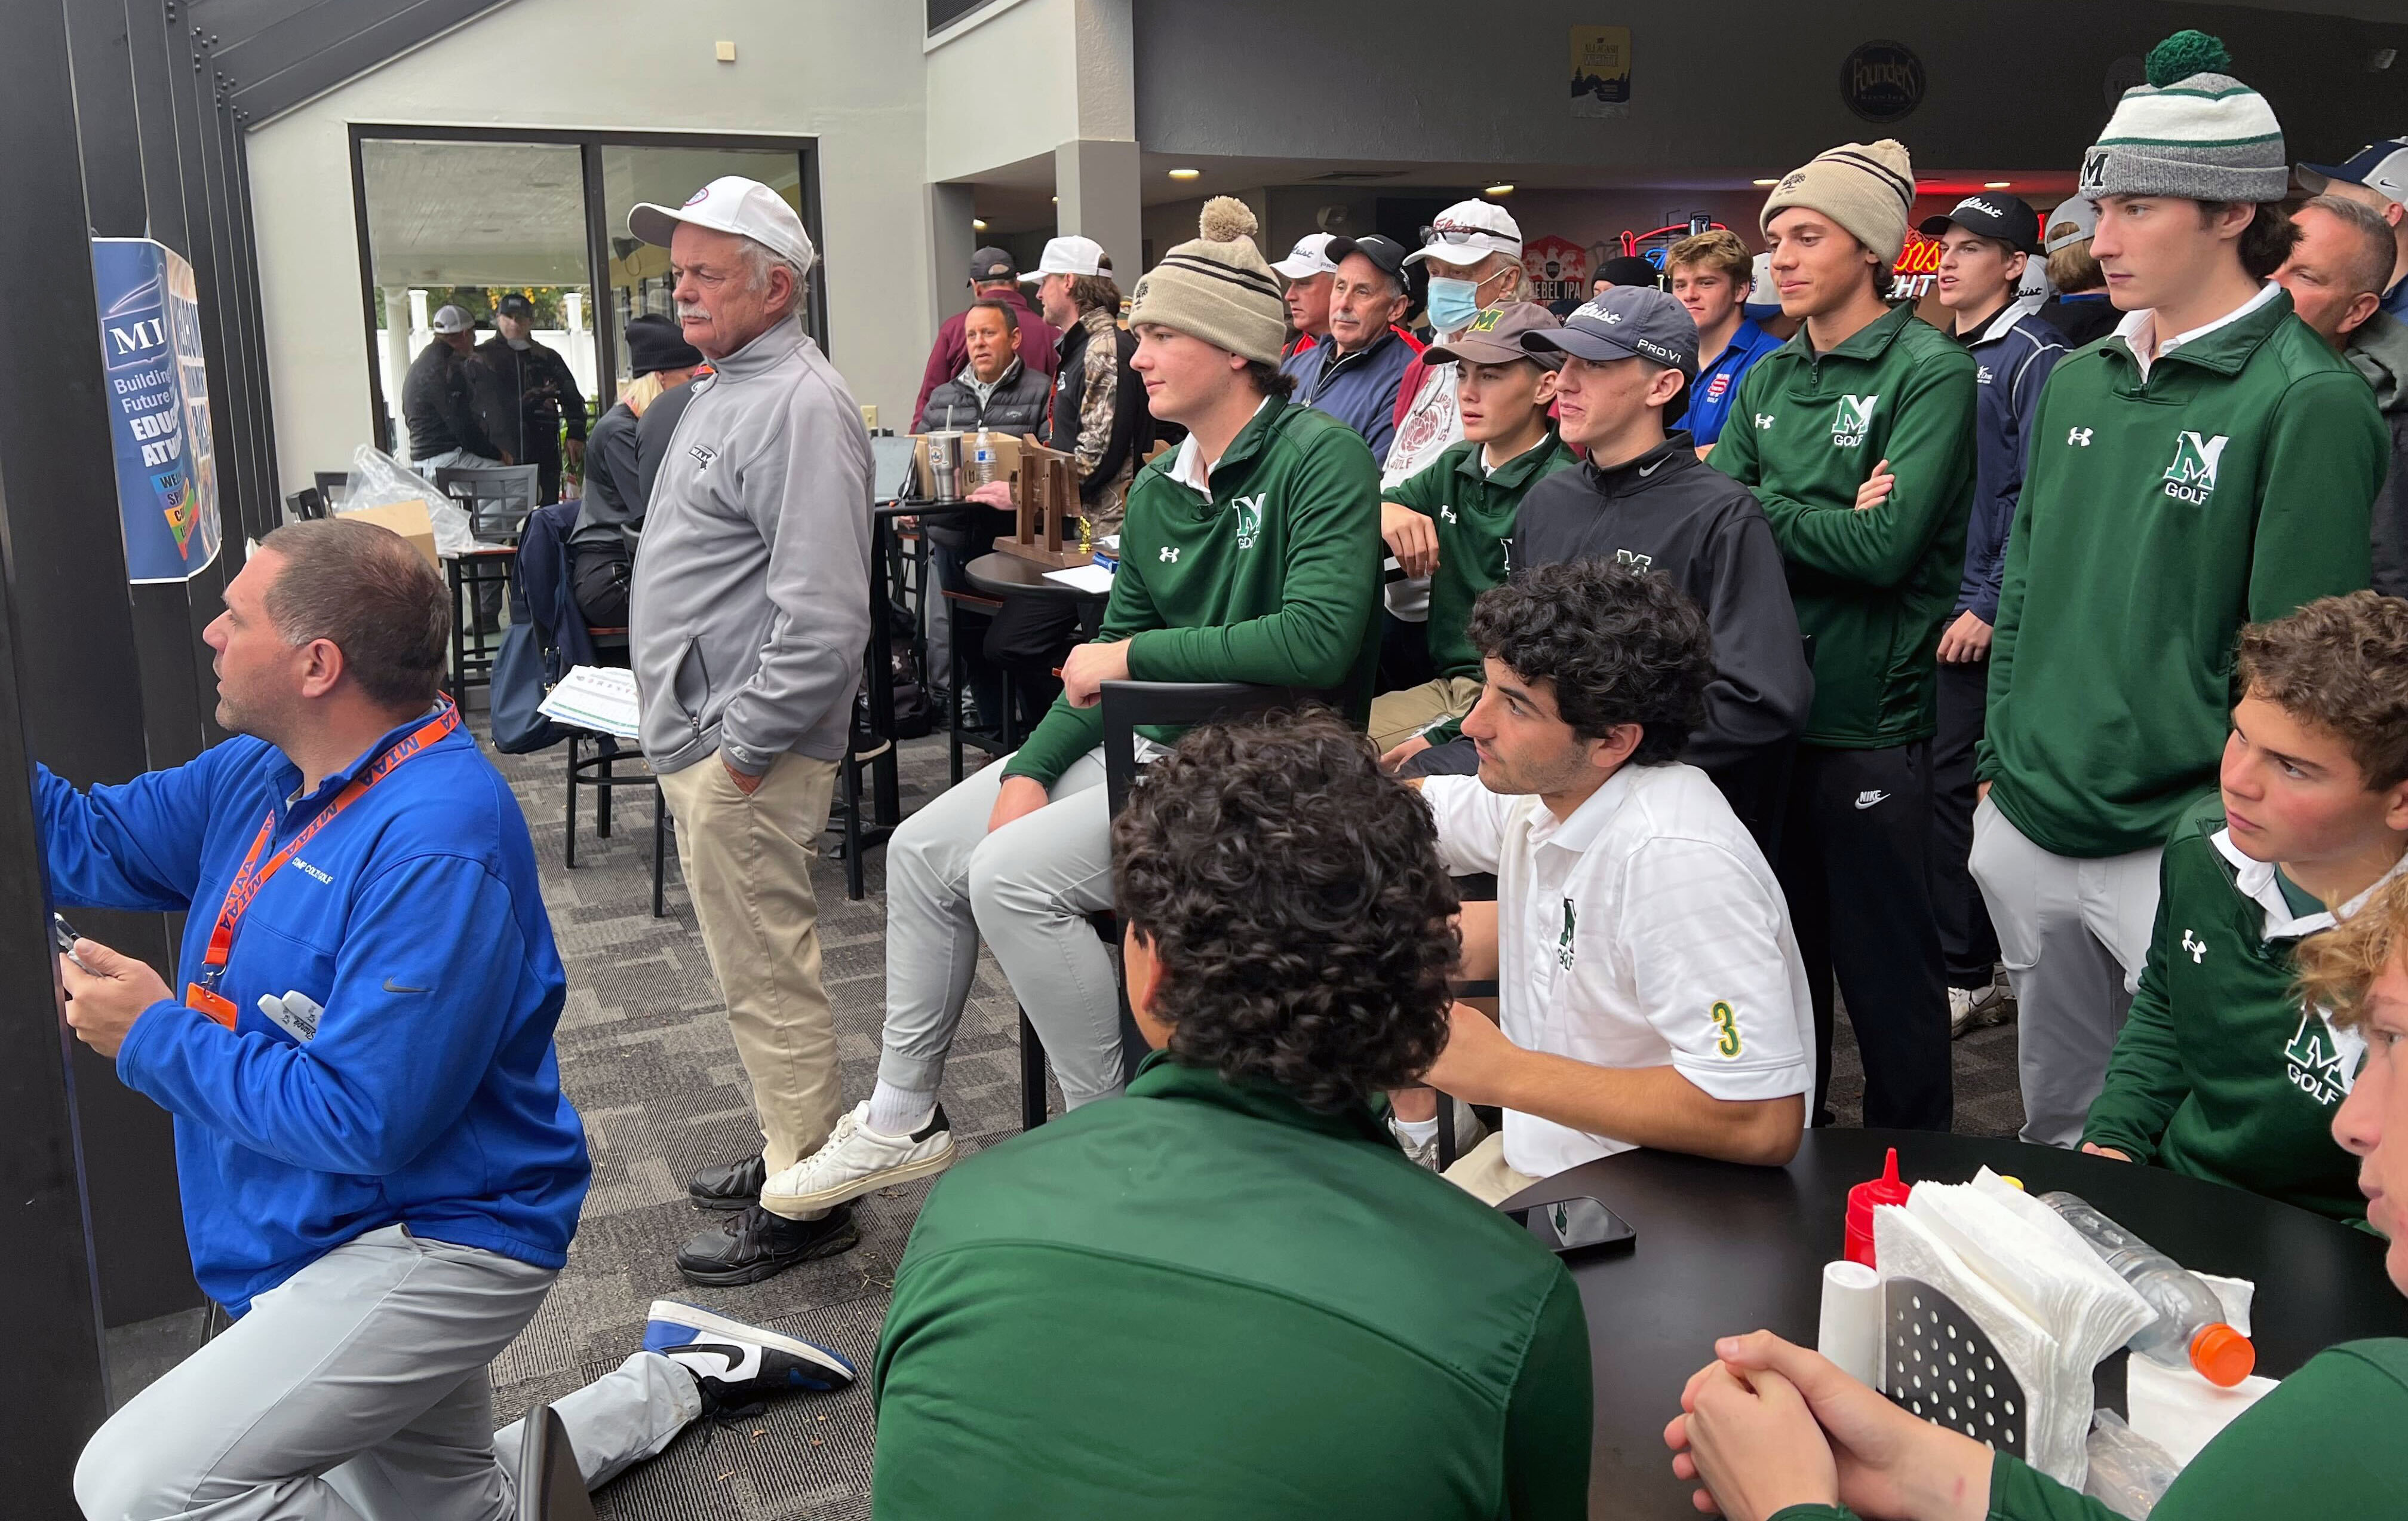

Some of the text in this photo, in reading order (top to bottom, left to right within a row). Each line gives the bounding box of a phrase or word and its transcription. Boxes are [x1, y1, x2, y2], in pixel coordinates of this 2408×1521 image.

[2081, 152, 2109, 188] M
[1564, 281, 1581, 299] IPA
[1637, 338, 1682, 363] PRO V1
[1833, 434, 1864, 447] GOLF
[2165, 482, 2209, 505] GOLF
[1859, 790, 1882, 802] NIKE
[1710, 999, 1742, 1058] 3
[2287, 1063, 2340, 1105] GOLF
